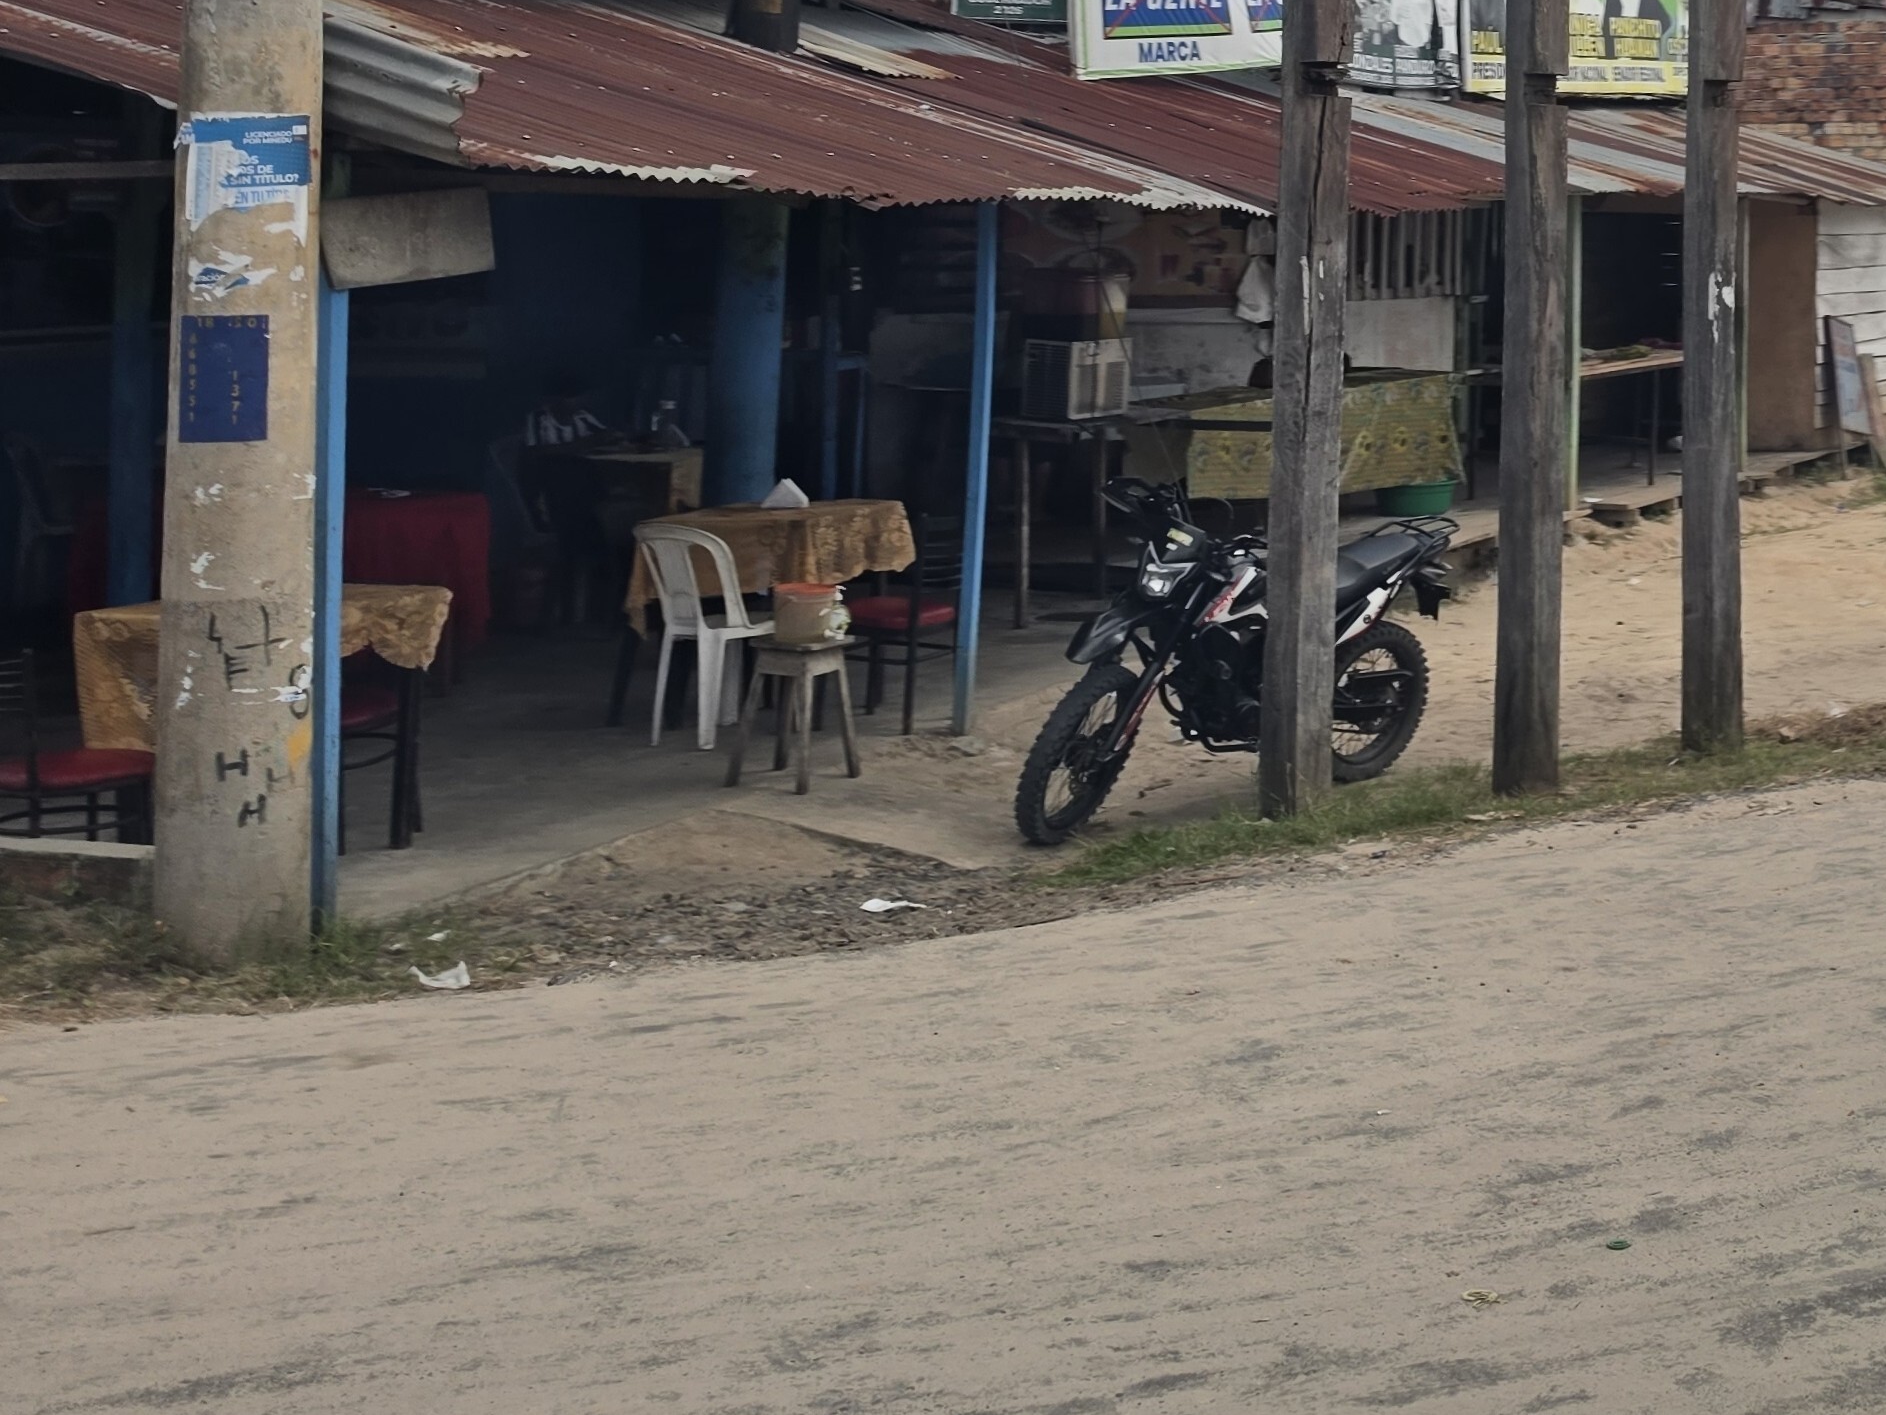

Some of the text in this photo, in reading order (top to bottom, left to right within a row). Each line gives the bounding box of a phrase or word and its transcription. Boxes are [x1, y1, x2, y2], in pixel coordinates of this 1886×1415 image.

[1137, 40, 1202, 64] MARCA
[244, 130, 293, 139] LICENCIADO
[242, 136, 293, 145] POR MINEDU
[256, 164, 275, 174] DE
[230, 176, 252, 186] SIN
[253, 172, 300, 184] TÍTULO?
